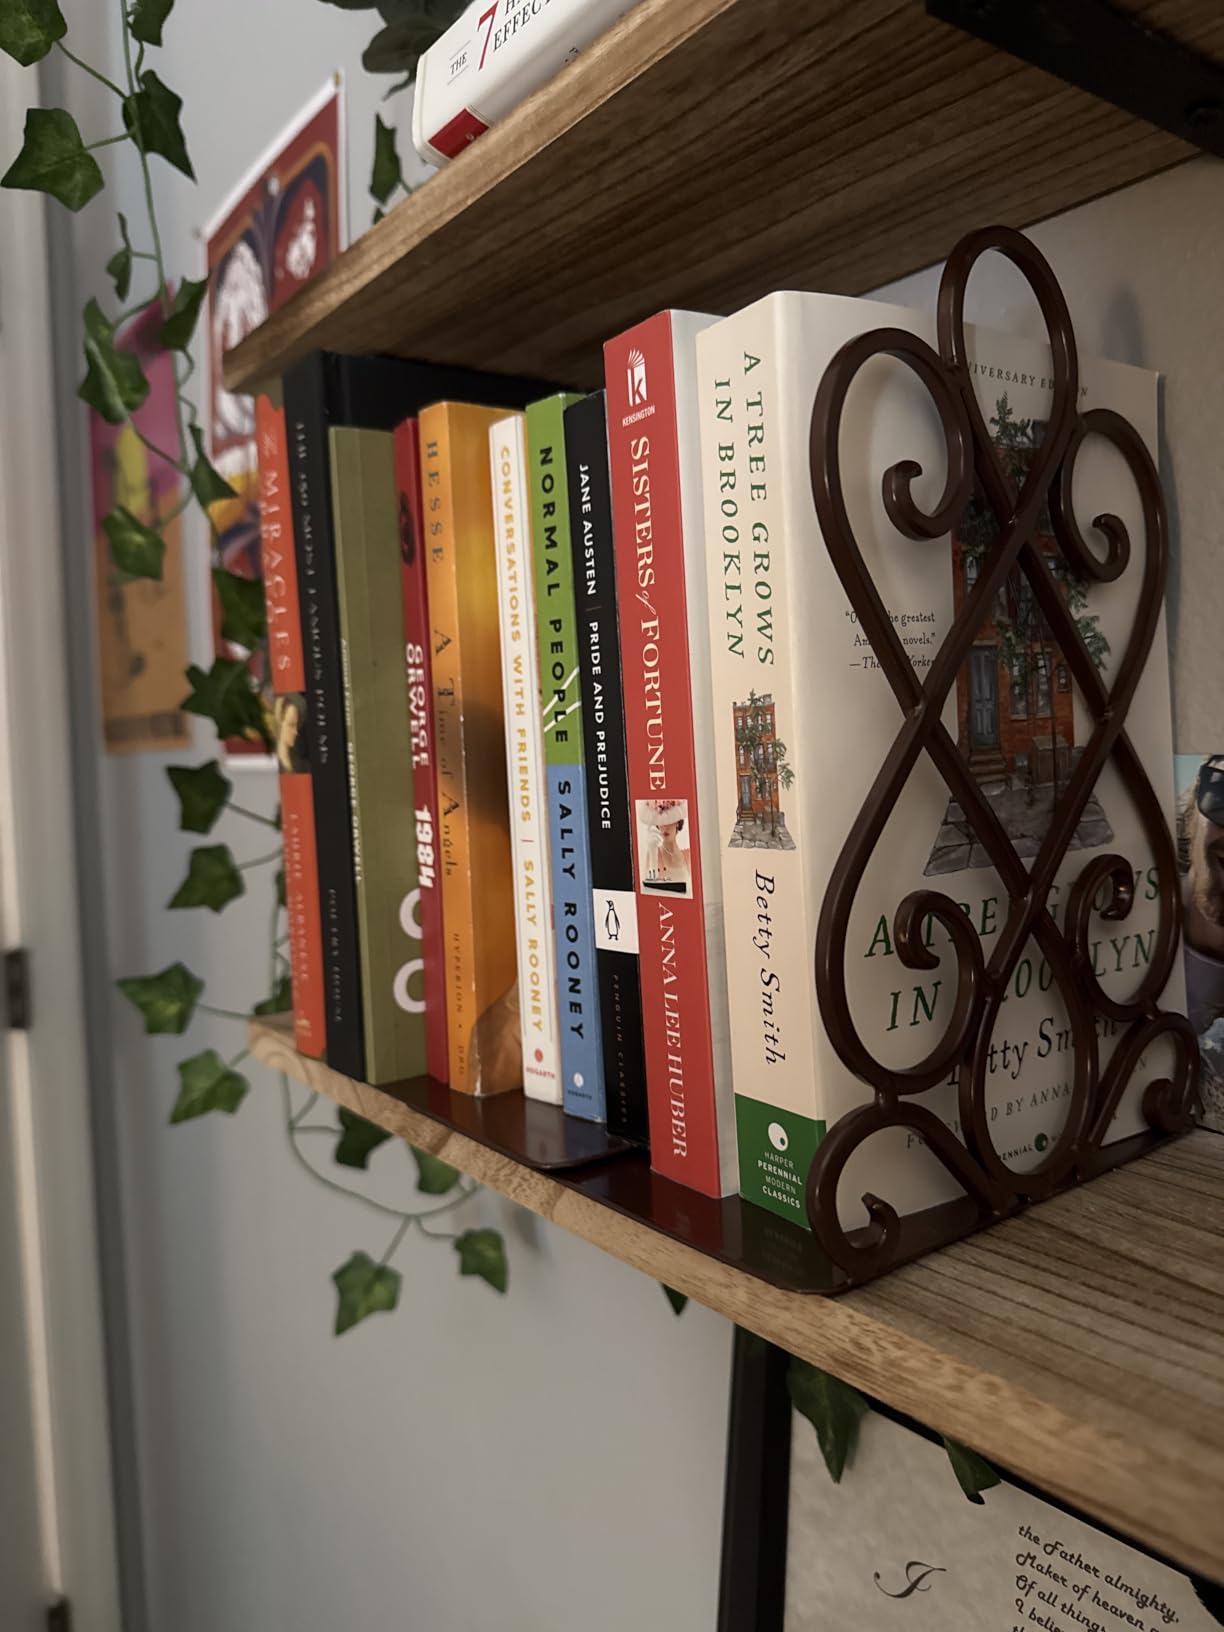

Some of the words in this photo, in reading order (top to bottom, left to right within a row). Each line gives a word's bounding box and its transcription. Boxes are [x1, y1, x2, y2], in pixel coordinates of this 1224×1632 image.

[477, 0, 499, 71] 7
[493, 0, 551, 52] EFFEC
[450, 52, 468, 75] THE
[744, 351, 762, 376] A
[622, 404, 656, 428] KENSINGTON
[714, 377, 733, 423] IN
[746, 391, 768, 502] TREE
[427, 439, 444, 564] HESSE
[540, 446, 560, 597] NORMAL
[579, 464, 592, 514] JANE
[631, 436, 655, 588] SISTERS
[264, 470, 291, 671] MIRACLES
[501, 446, 522, 643] CONVERSATIONS
[583, 520, 596, 596] AUSTEN
[718, 441, 745, 659] BROOKLYN
[635, 590, 657, 616] of
[751, 521, 775, 666] GROWS
[901, 611, 936, 627] greatest
[434, 629, 452, 657] A
[589, 621, 602, 676] PRIDE
[406, 643, 420, 769] ORWELL
[414, 644, 430, 767] GEORGE
[437, 677, 456, 743] Time
[512, 655, 525, 716] WITH
[549, 618, 568, 743] PEOPLE
[593, 682, 604, 724] AND
[641, 615, 666, 791] FORTUNE
[517, 728, 531, 822] FRIENDS
[596, 730, 611, 830] PREJUDICE
[347, 742, 357, 808] GEORGE
[352, 815, 362, 882] ORWELL
[414, 803, 436, 888] 1984
[442, 791, 460, 877] Angels
[558, 780, 575, 880] SALLY
[524, 860, 537, 926] SALLY
[753, 868, 775, 960] Betty
[564, 902, 584, 1040] ROONEY
[659, 902, 678, 985] ANNA
[864, 914, 894, 958] A
[453, 932, 463, 1013] HYPERION
[528, 939, 543, 1032] ROONEY
[886, 980, 942, 1032] IN
[612, 974, 623, 1043] PENGUIN
[664, 992, 681, 1049] LEE
[759, 967, 786, 1066] Smith
[526, 1066, 556, 1080] HOGARTH
[567, 1089, 593, 1100] HOGARTH
[667, 1055, 687, 1158] HUBER
[1005, 1097, 1025, 1117] BY
[1030, 1081, 1071, 1108] ANNA
[757, 1160, 803, 1186] PERENNIAL
[764, 1151, 794, 1169] HARPER
[765, 1175, 797, 1195] MODERN
[762, 1185, 801, 1209] CLASSICS
[1018, 1525, 1040, 1545] the
[1043, 1541, 1100, 1578] Father
[1015, 1574, 1037, 1598] Of
[1037, 1590, 1058, 1608] all
[1015, 1551, 1068, 1588] Maker
[1072, 1584, 1091, 1601] of
[1092, 1590, 1144, 1632] heaven
